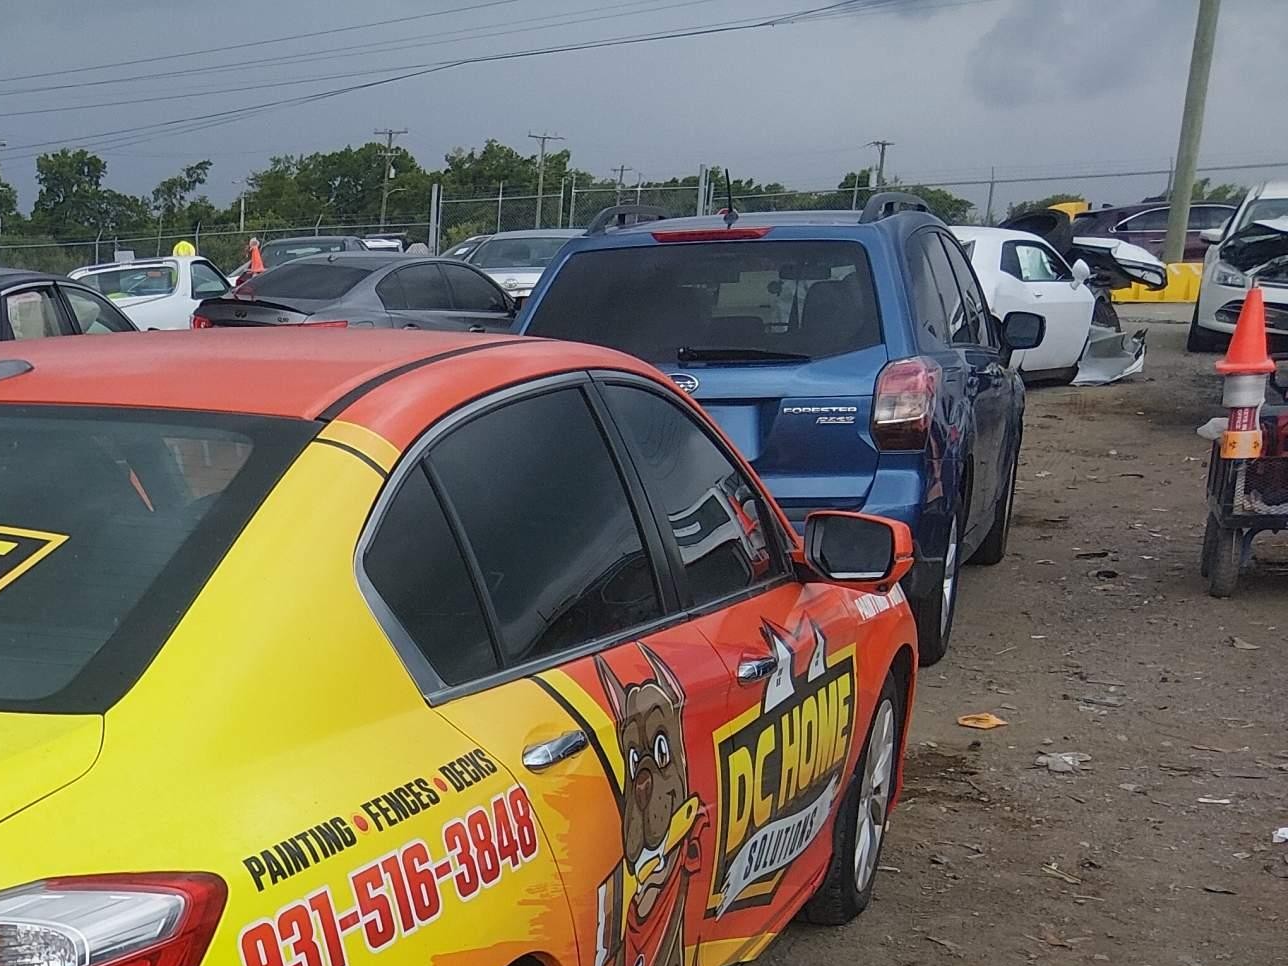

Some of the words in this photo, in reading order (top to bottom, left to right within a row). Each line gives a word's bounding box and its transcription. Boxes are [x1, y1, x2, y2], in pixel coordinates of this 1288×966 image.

[783, 406, 857, 415] FORESTER
[726, 722, 777, 855] DC
[777, 671, 854, 810] HOME
[242, 816, 357, 892] PAINTING
[360, 777, 441, 832] FENCES
[438, 748, 498, 793] DECKS
[743, 809, 818, 881] SOLUTIONS
